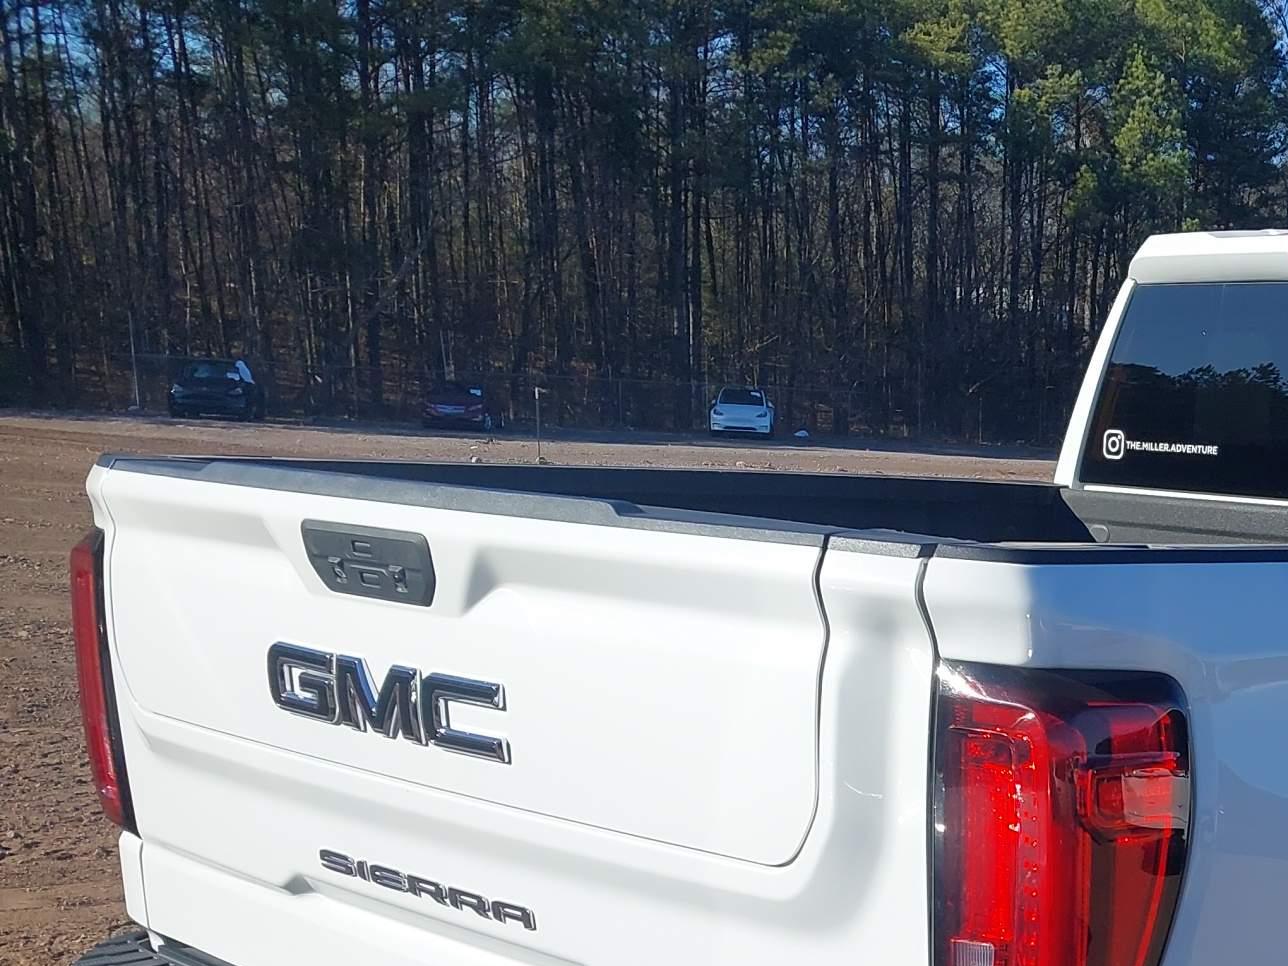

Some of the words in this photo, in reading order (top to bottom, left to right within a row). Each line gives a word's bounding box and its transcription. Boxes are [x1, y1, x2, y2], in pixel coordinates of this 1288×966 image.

[1126, 440, 1219, 456] THE.MILLER.ADVENTURE
[266, 640, 512, 766] GMC
[319, 848, 537, 932] SIERRA
